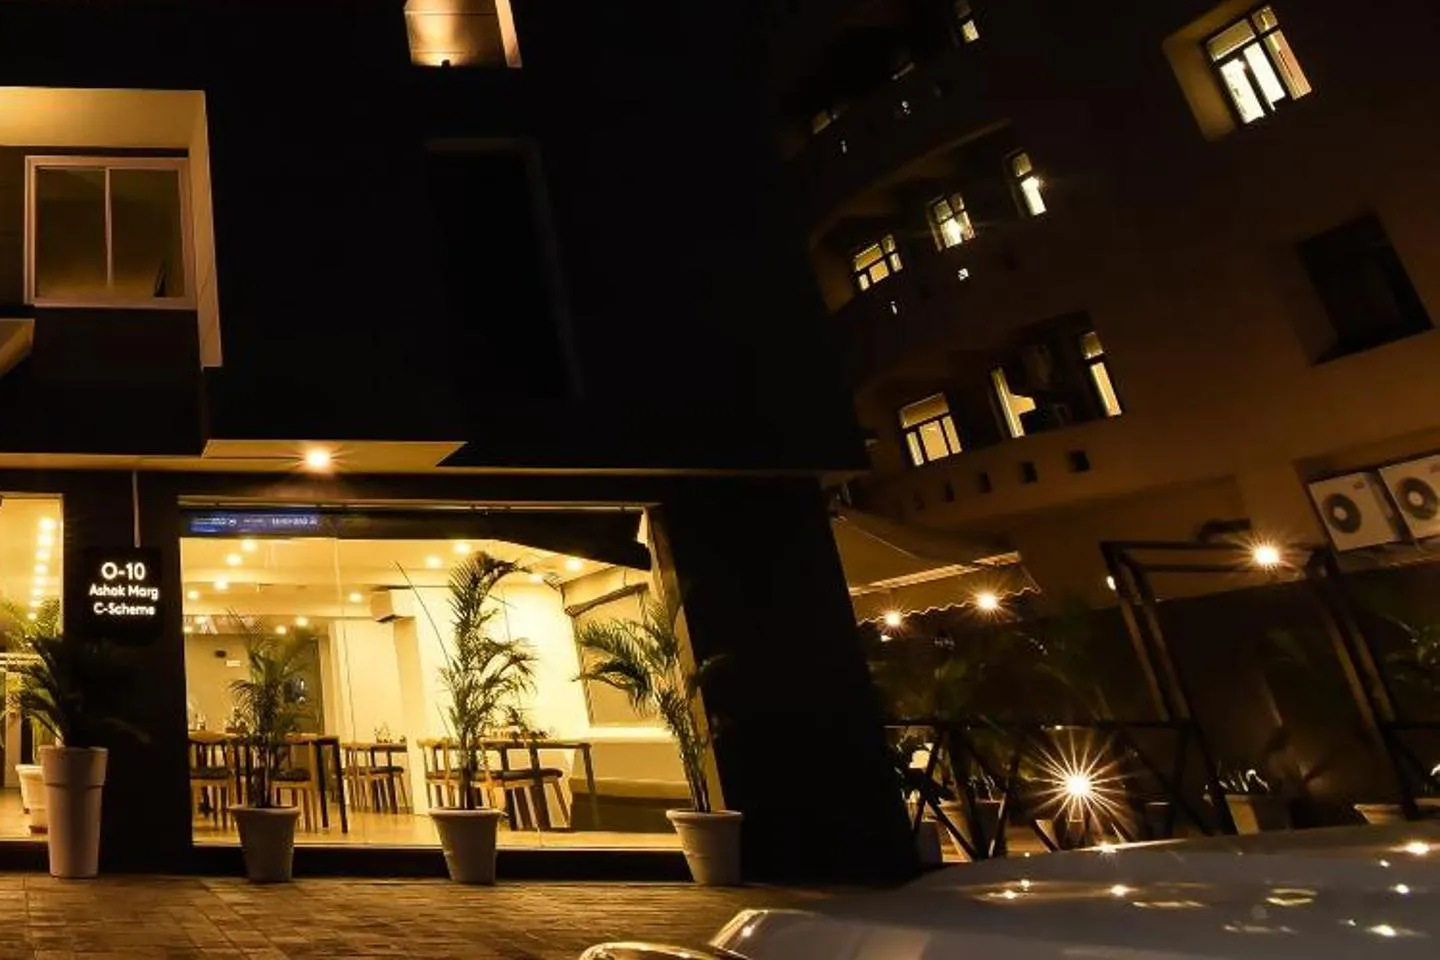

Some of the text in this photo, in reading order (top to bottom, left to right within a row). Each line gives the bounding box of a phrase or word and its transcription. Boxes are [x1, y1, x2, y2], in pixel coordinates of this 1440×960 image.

[89, 583, 159, 601] Ashok Marg
[93, 602, 156, 615] C-Scheme
